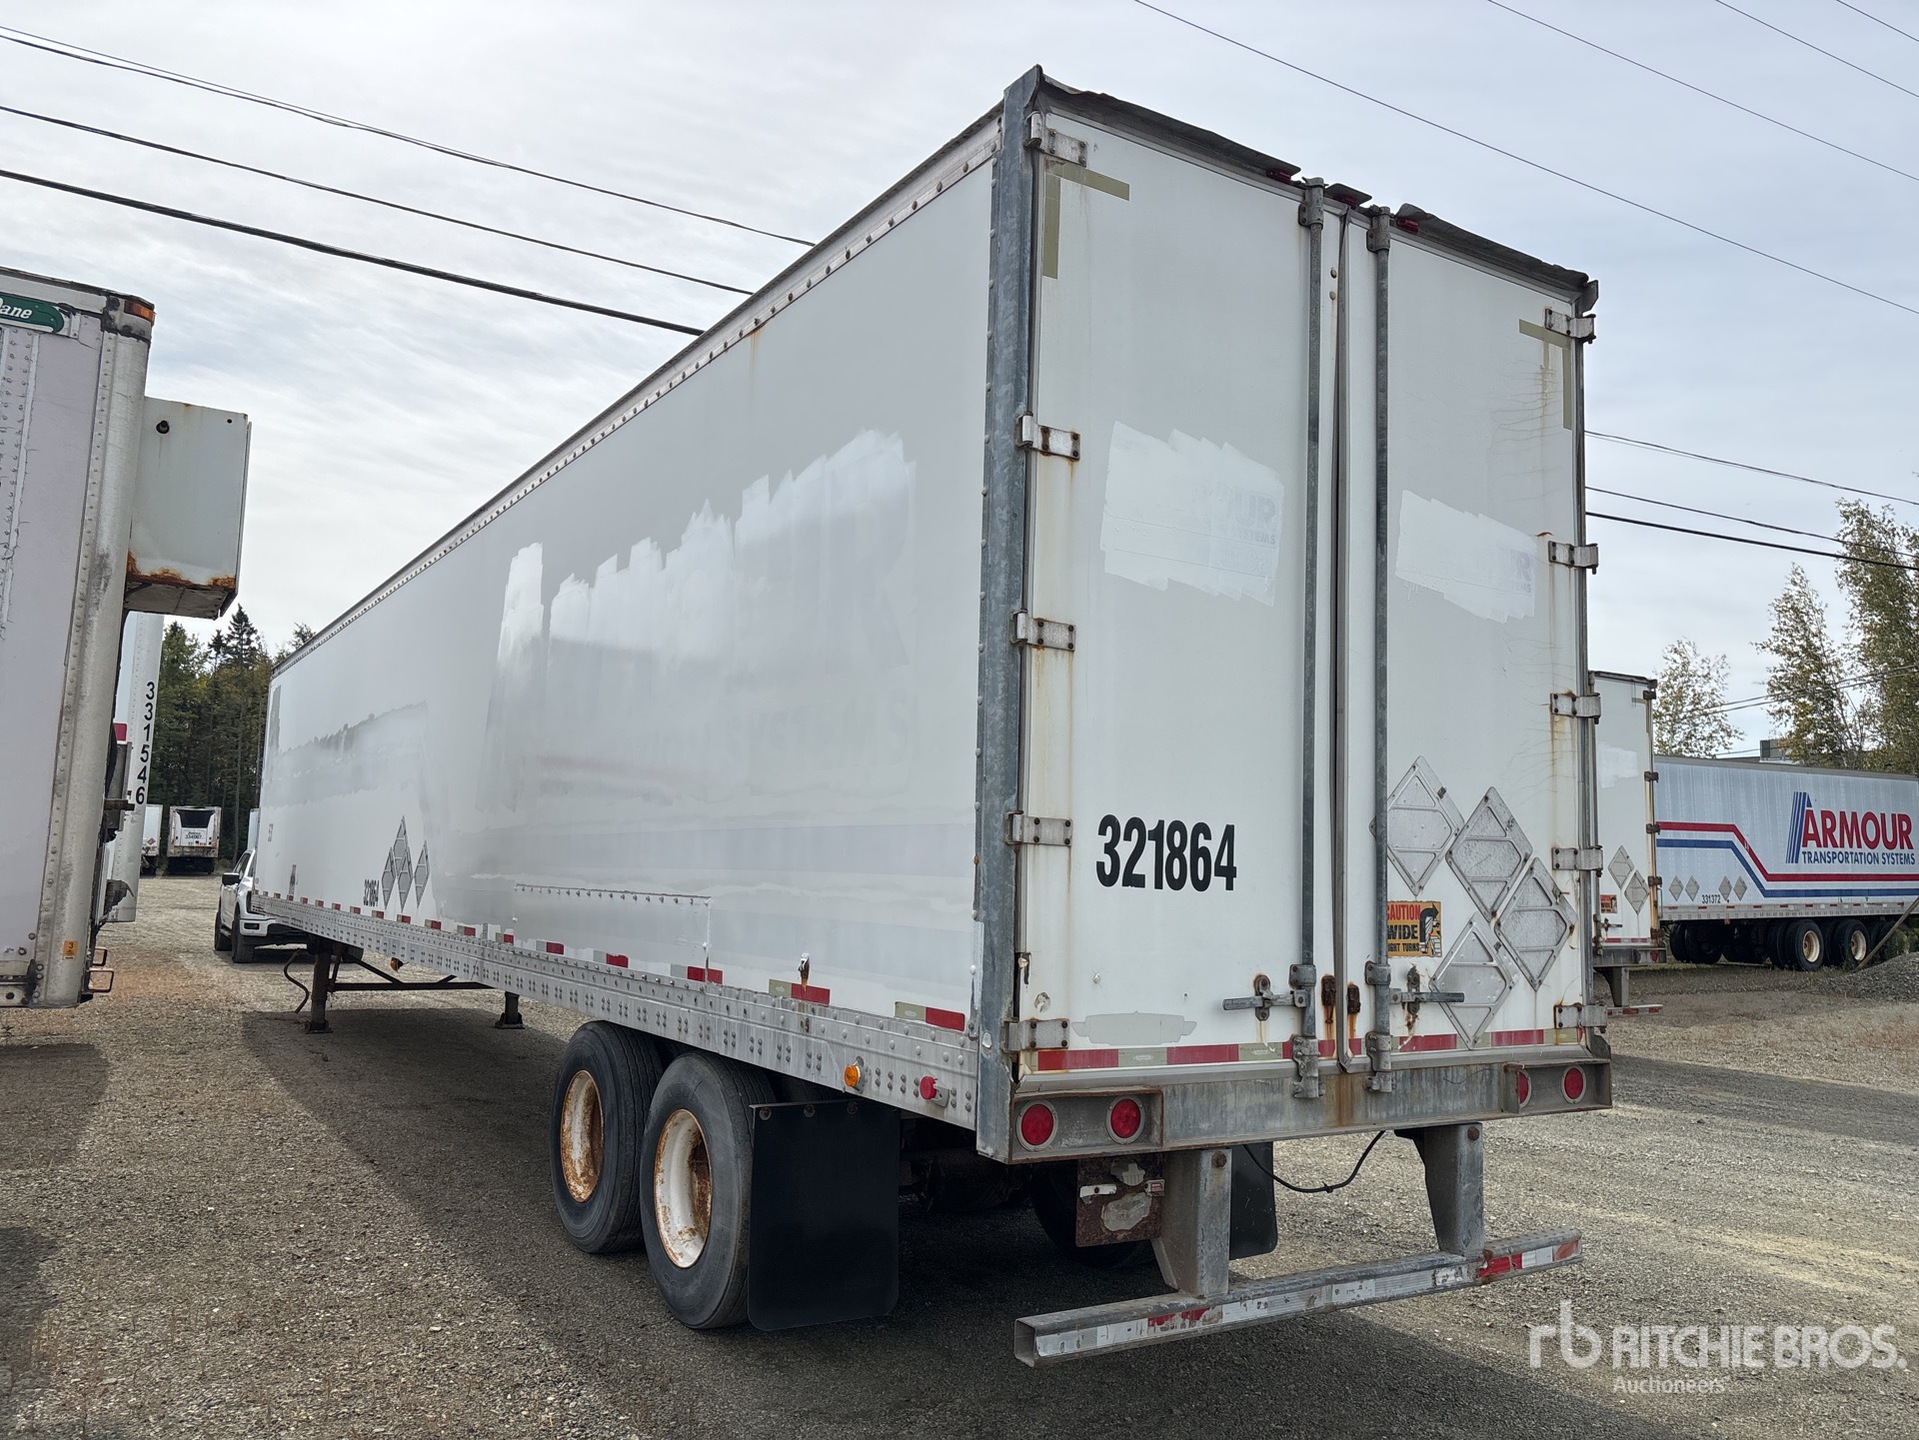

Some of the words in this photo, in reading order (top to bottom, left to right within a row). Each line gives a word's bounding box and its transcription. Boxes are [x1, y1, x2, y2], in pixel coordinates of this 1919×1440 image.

[135, 681, 155, 805] 331546
[1801, 808, 1914, 851] ARMOUR
[1096, 814, 1237, 892] 321864
[1801, 851, 1880, 865] TRANSPORTATION
[1881, 852, 1916, 865] SYSTEMS
[1701, 894, 1721, 904] 331372
[1387, 924, 1419, 940] WIDE
